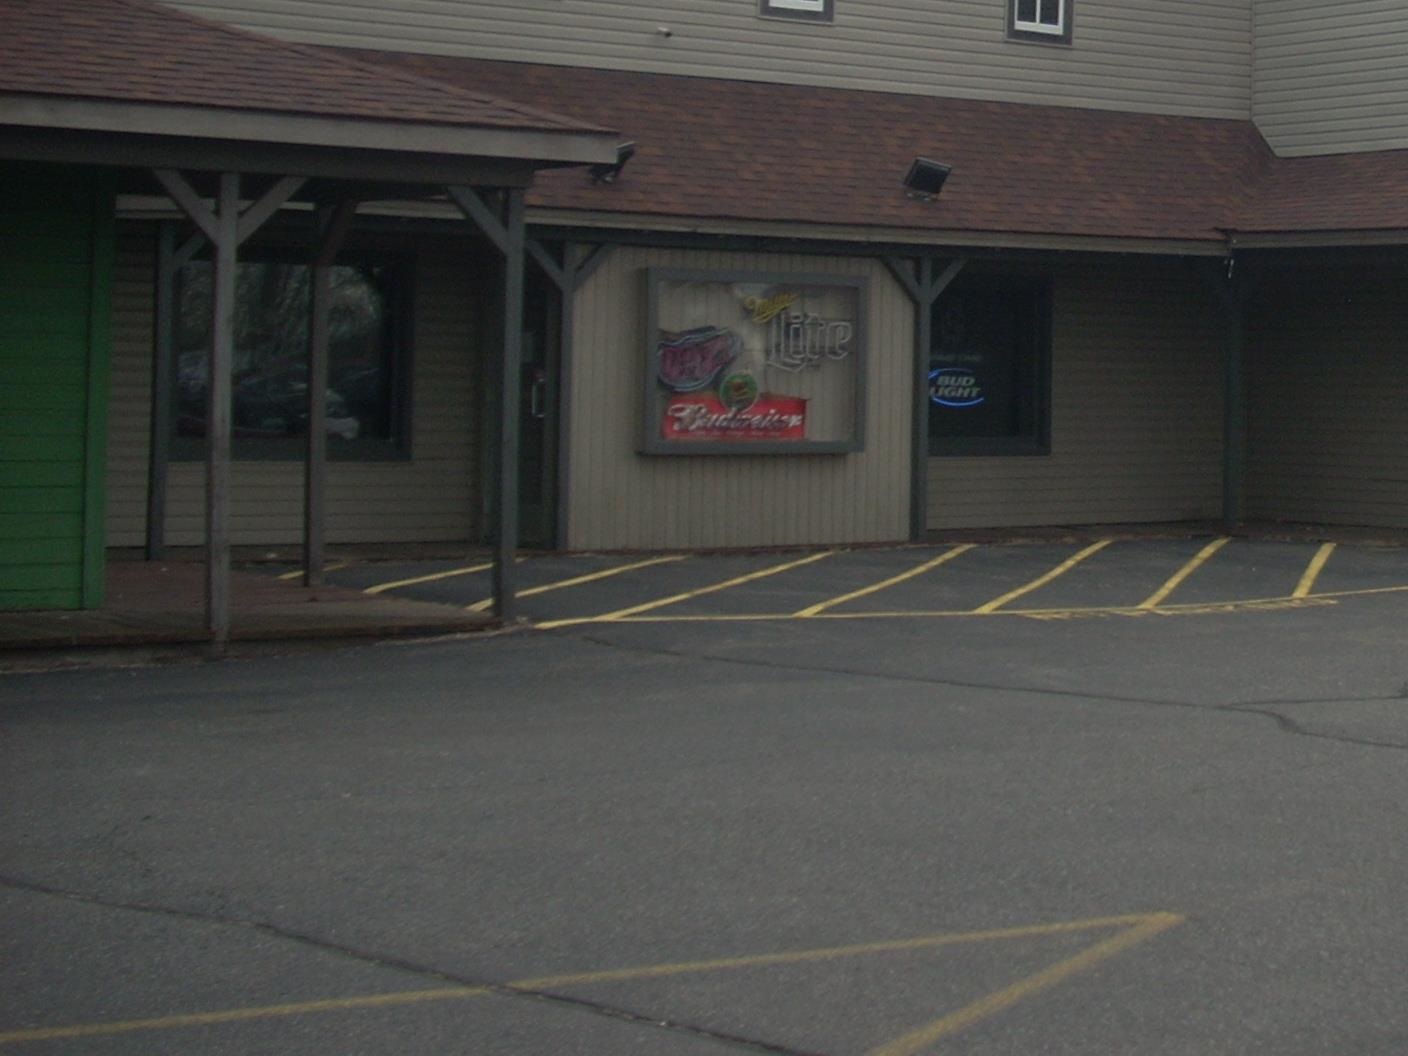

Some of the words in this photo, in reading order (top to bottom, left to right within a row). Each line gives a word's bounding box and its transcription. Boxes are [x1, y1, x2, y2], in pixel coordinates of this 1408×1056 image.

[766, 312, 853, 372] Lite
[937, 375, 976, 386] BUD
[929, 386, 982, 397] LIGHT
[667, 403, 804, 432] Budweiser
